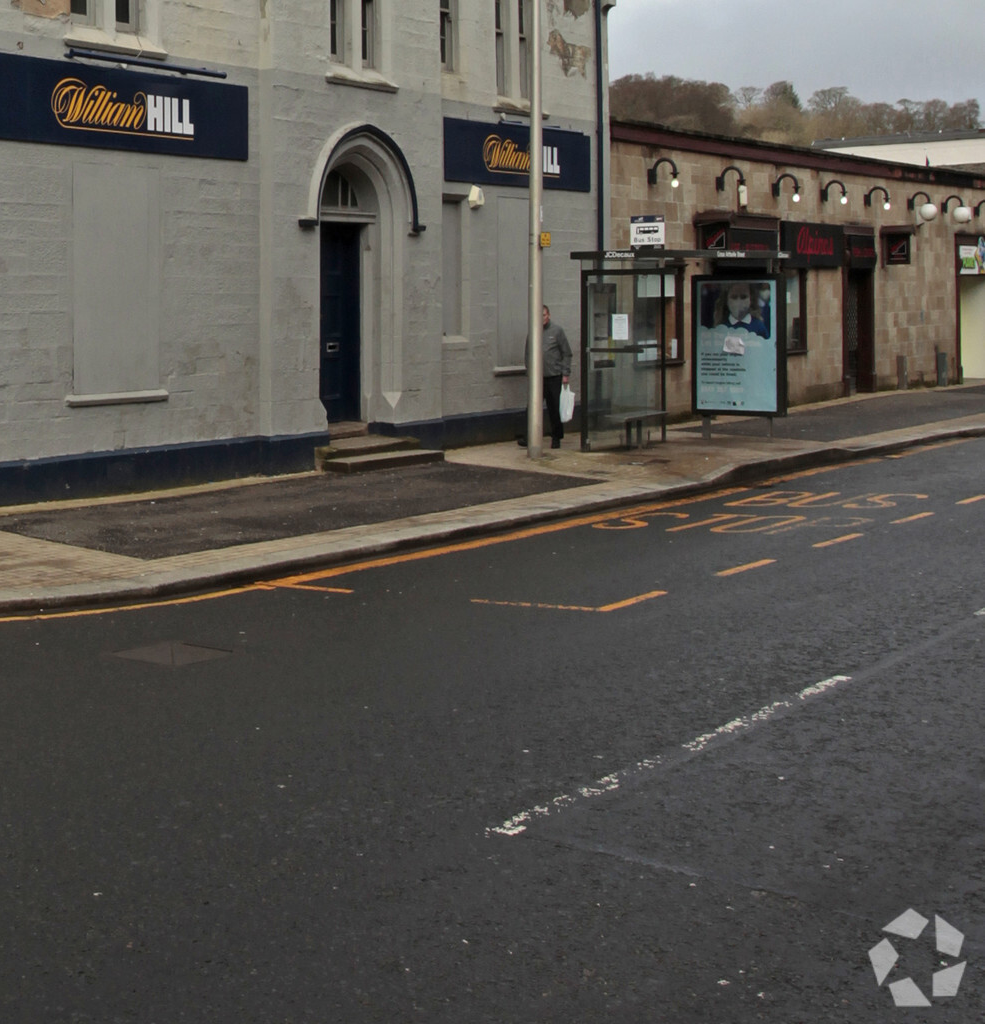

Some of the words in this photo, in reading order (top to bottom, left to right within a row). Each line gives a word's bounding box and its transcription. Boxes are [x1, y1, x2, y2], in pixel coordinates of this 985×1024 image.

[50, 77, 147, 130] William
[147, 84, 195, 135] HILL
[543, 144, 561, 175] ILL
[723, 491, 929, 509] BUS
[592, 511, 875, 535] STOP
